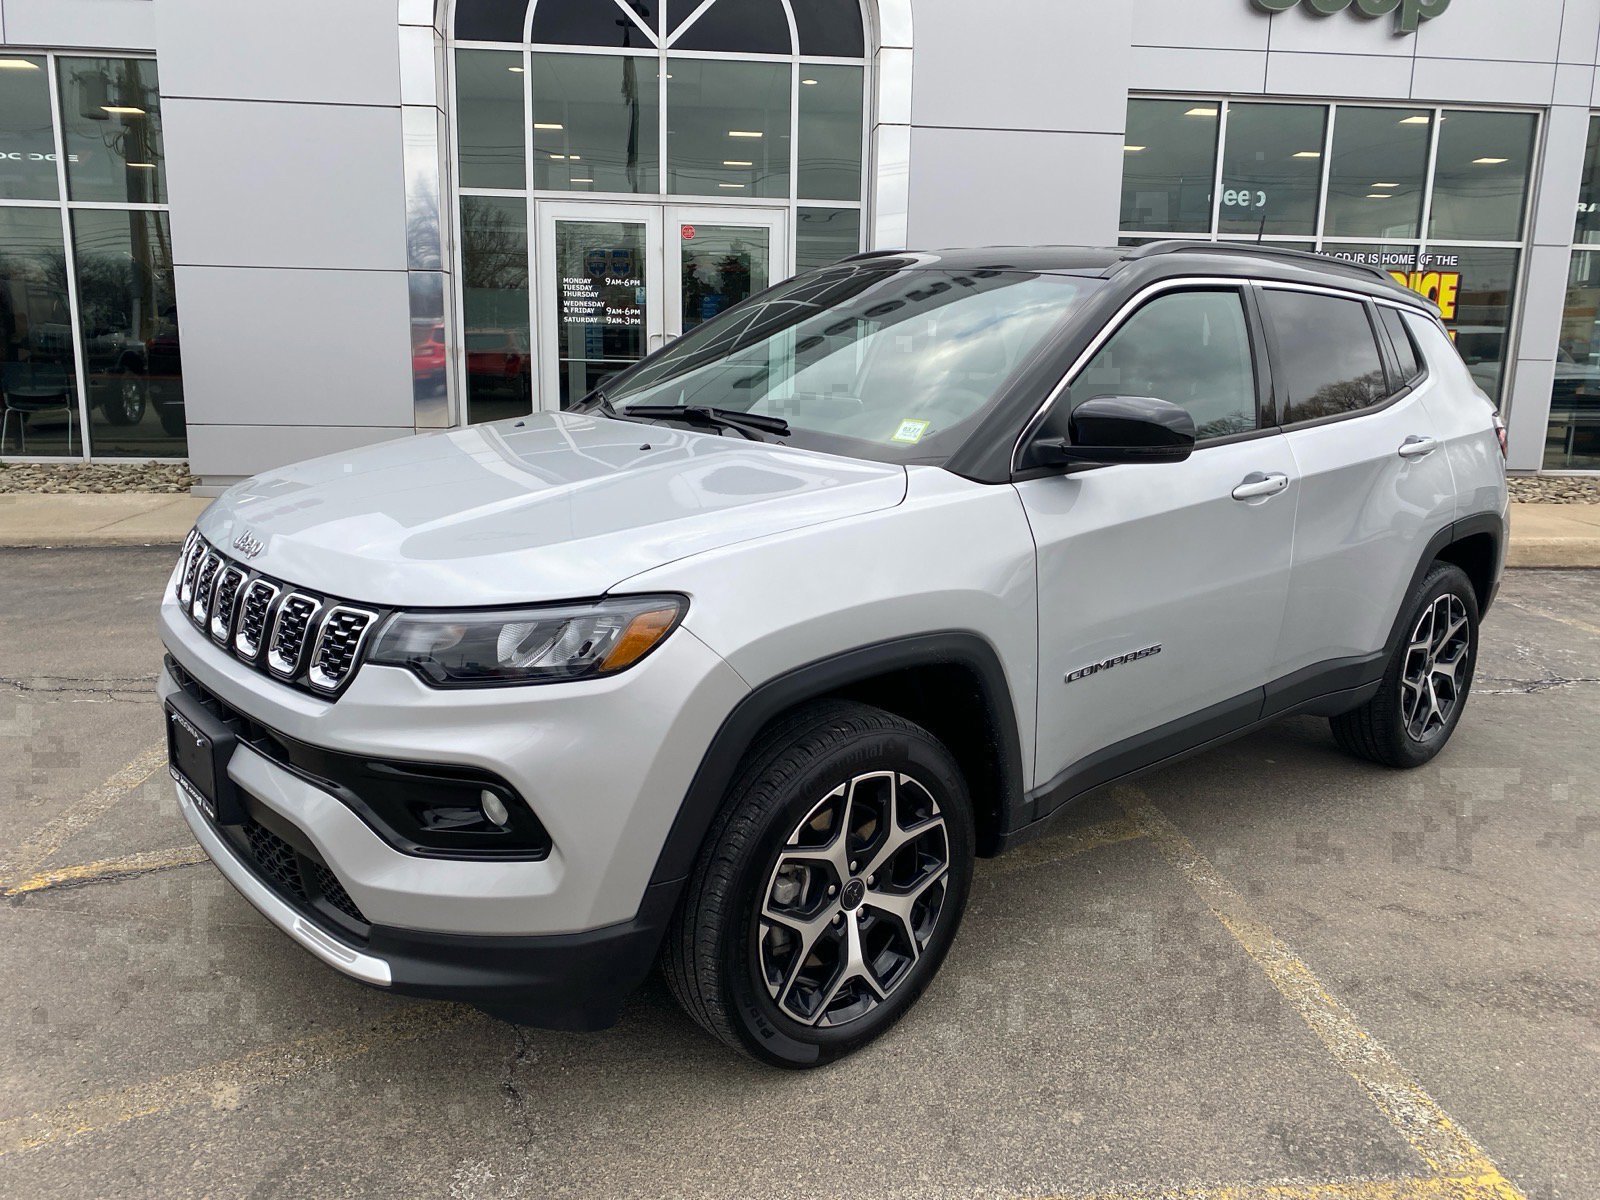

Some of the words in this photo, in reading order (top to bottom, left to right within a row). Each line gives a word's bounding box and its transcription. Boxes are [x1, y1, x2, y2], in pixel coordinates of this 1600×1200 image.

[1368, 253, 1379, 264] IS
[1381, 253, 1416, 265] HOME
[1420, 255, 1433, 265] OF
[1435, 255, 1458, 266] THE
[563, 300, 605, 308] WEDNESDAY
[1064, 643, 1162, 684] COMPASS
